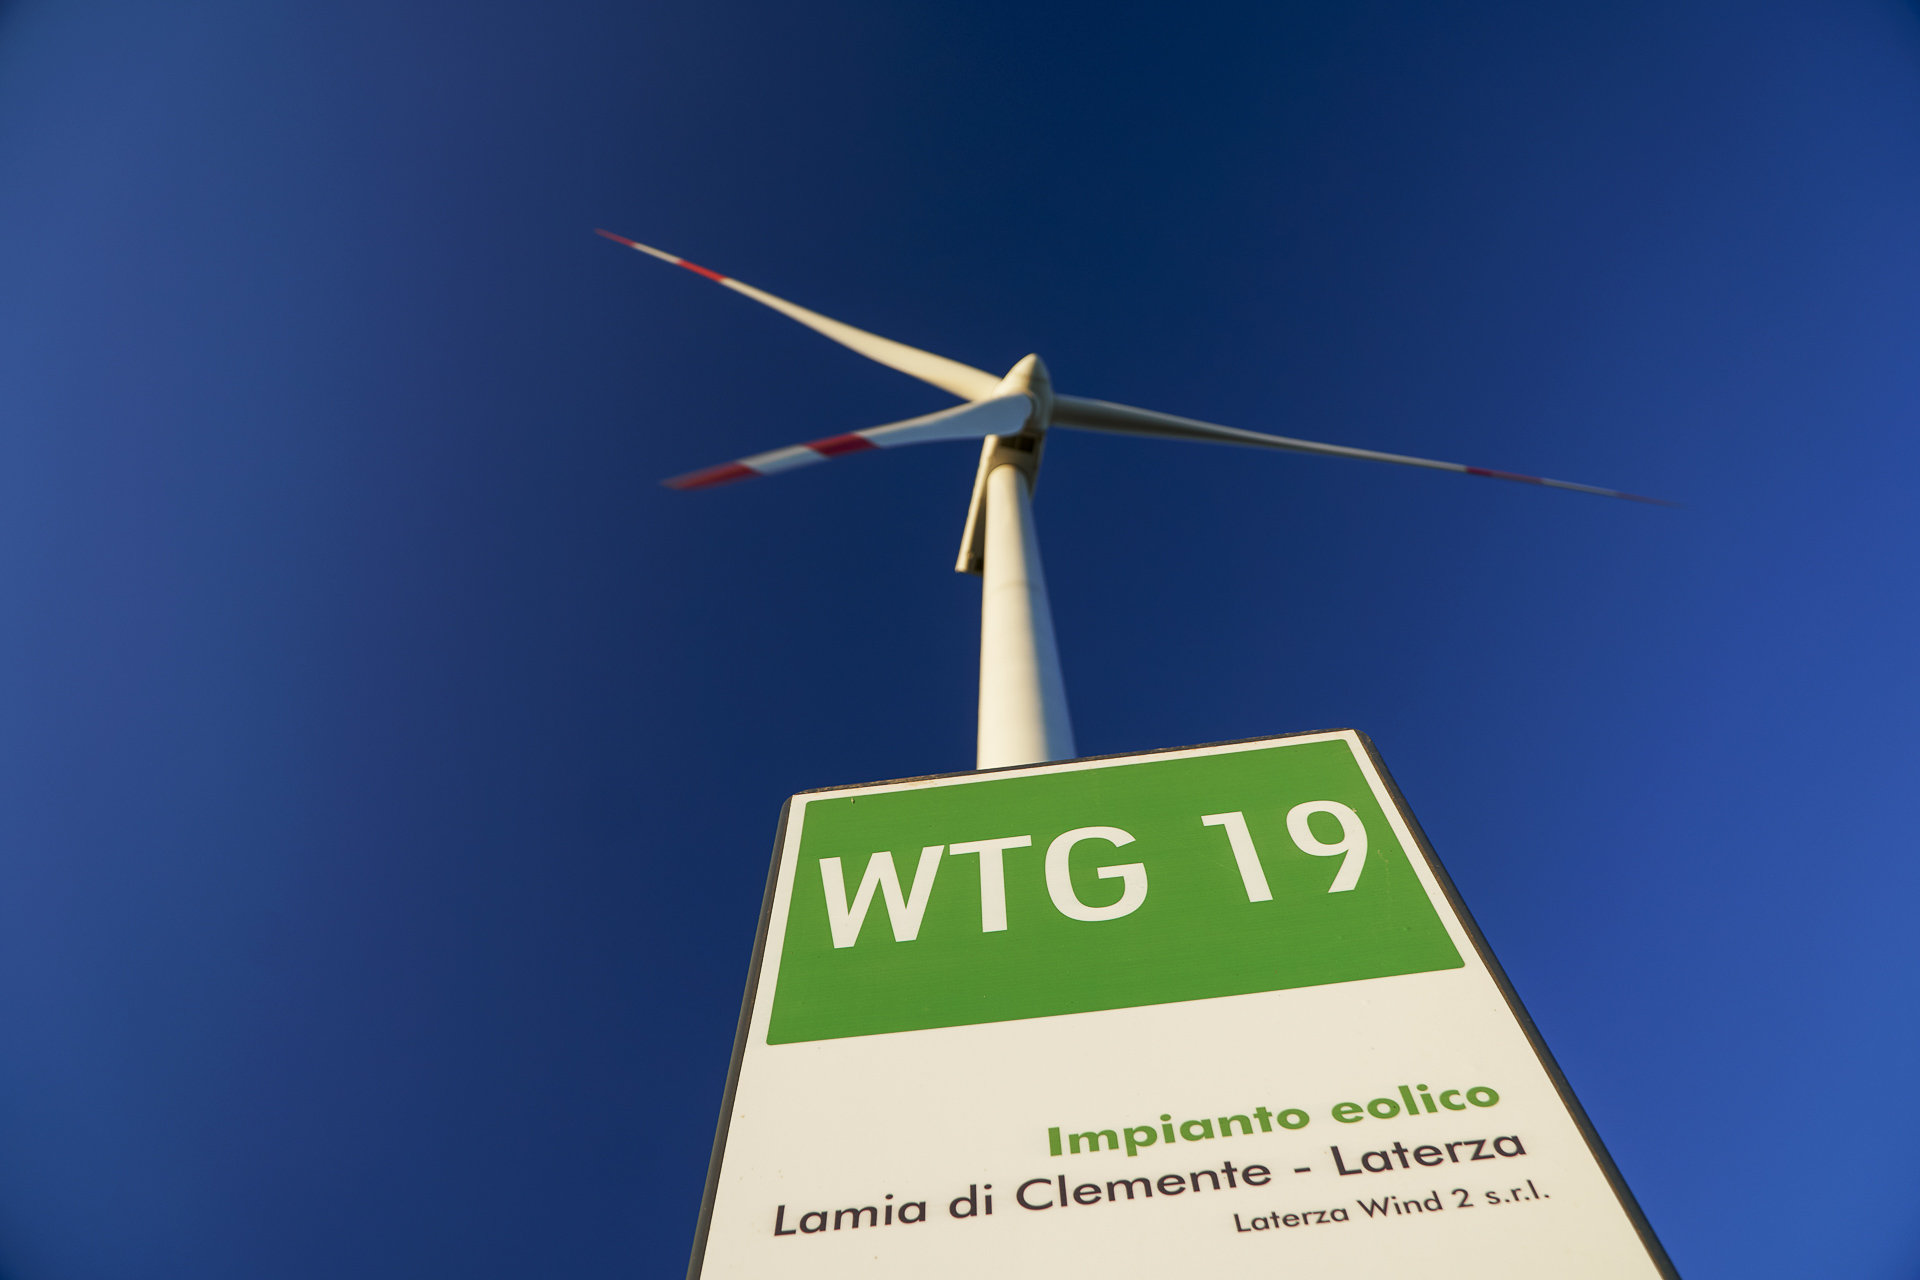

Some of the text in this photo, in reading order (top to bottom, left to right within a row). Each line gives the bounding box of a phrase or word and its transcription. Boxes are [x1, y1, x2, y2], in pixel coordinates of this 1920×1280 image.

[819, 800, 1368, 949] WTG 19
[1048, 1083, 1500, 1157] Impianto eolico
[773, 1193, 927, 1237] Lamia
[949, 1183, 993, 1219] di
[1016, 1160, 1271, 1211] Clemente
[1330, 1134, 1527, 1176] Laterza
[1233, 1179, 1550, 1232] Laterza Wind 2 s.r.l.
